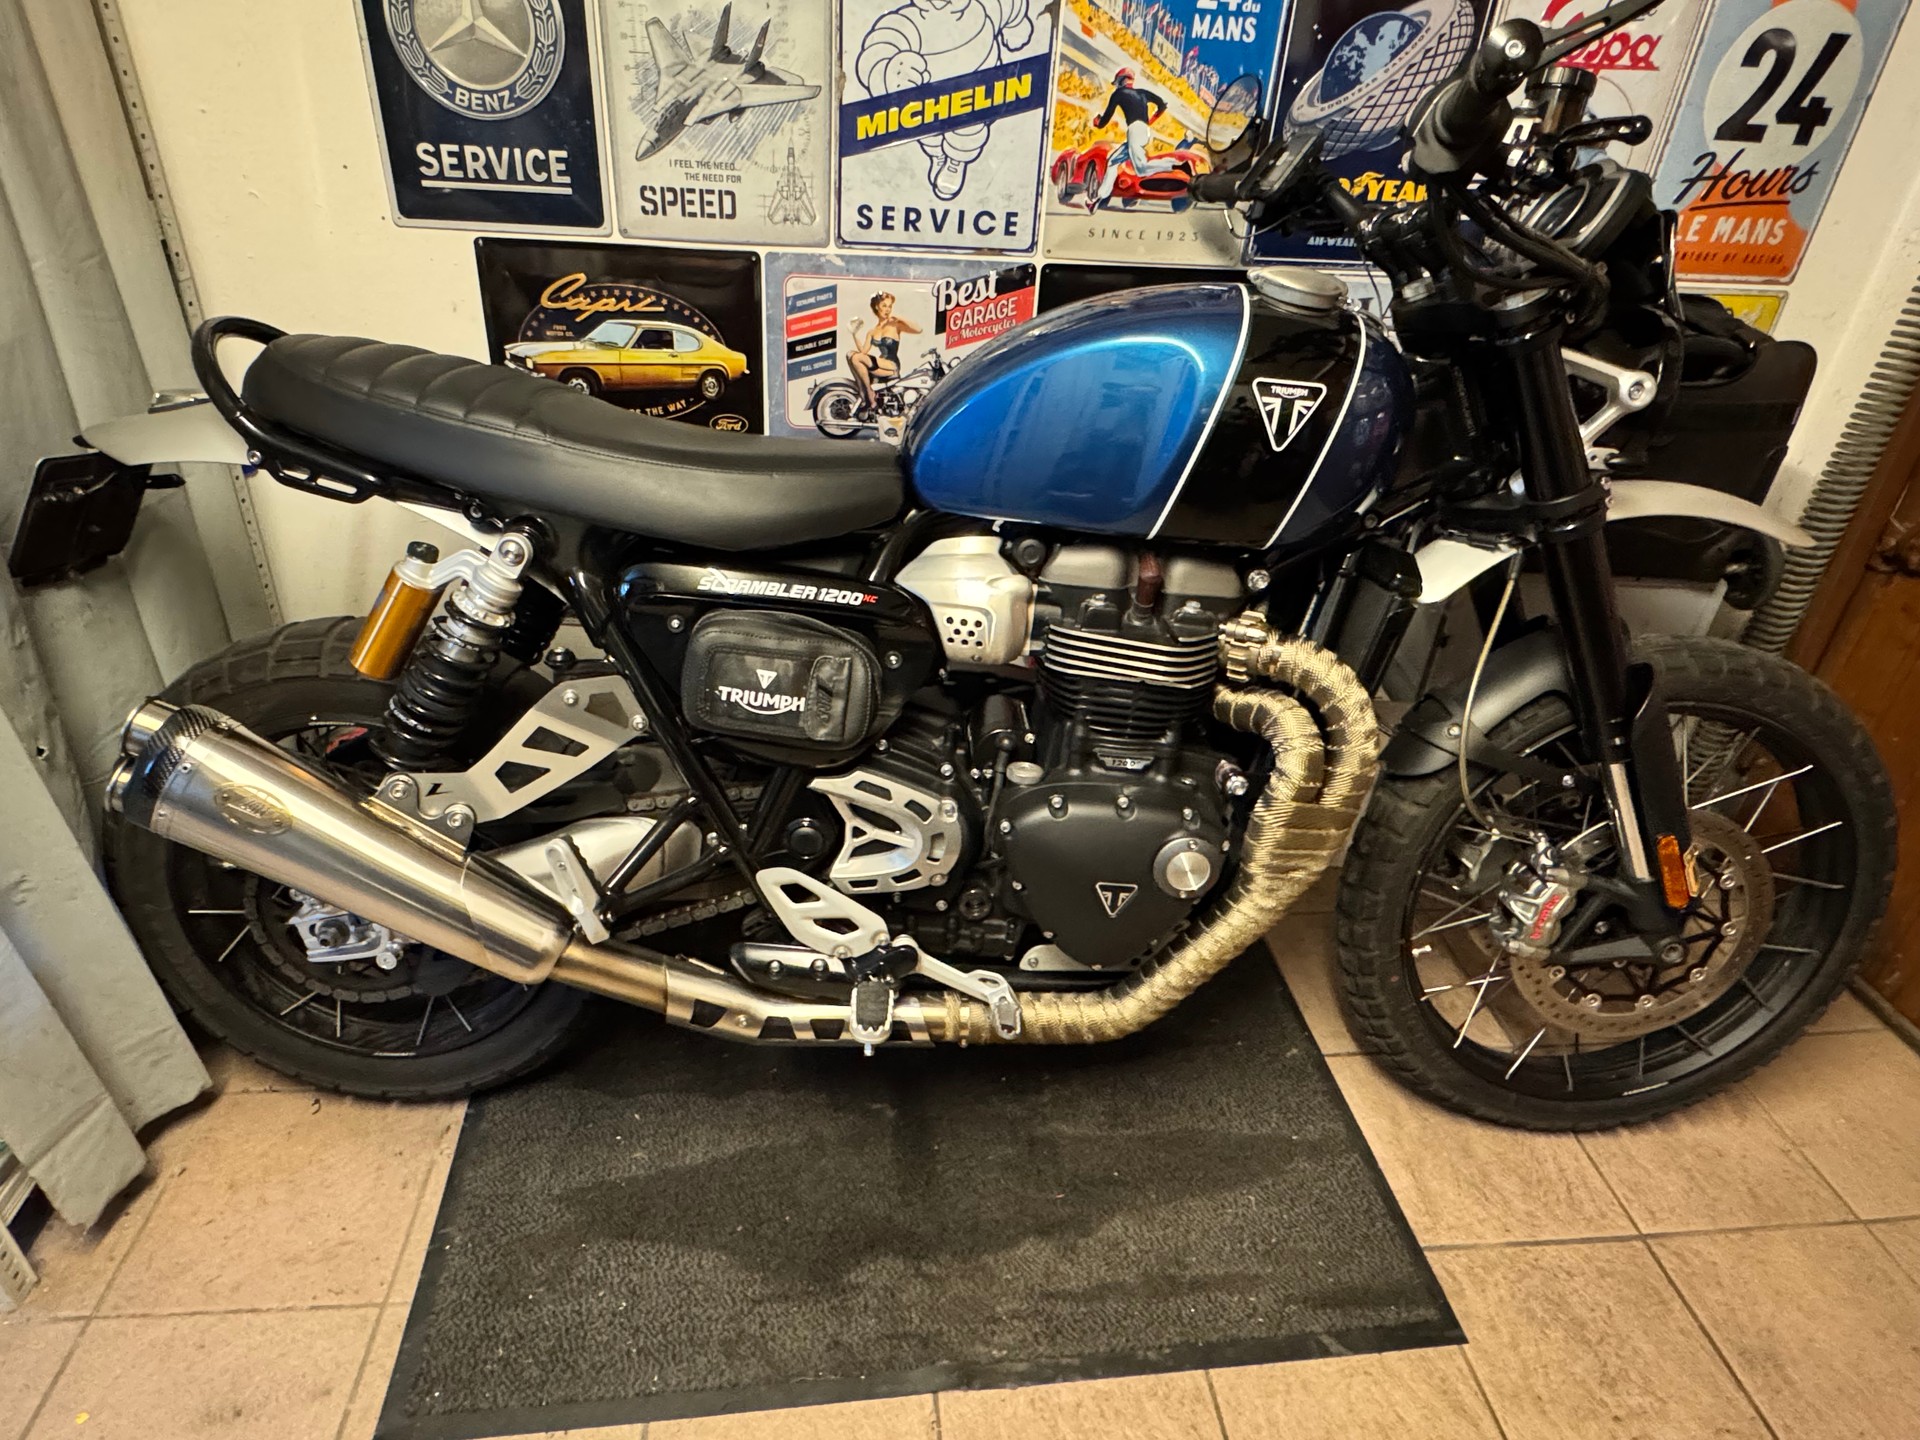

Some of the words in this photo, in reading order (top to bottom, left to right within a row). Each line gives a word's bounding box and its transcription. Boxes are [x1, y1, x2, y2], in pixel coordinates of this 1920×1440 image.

[1191, 13, 1257, 43] MANS
[455, 87, 516, 112] BENZ
[1714, 28, 1851, 147] 24
[856, 73, 1032, 141] MICHELIN
[415, 142, 571, 184] SERVICE
[674, 159, 694, 169] FEEL
[696, 160, 712, 170] THE
[1672, 148, 1820, 204] Hours
[684, 172, 701, 182] THE
[702, 173, 724, 183] NEED
[726, 174, 742, 184] FOR
[639, 185, 737, 220] SPEED
[856, 203, 1019, 237] SERVICE
[1088, 227, 1146, 241] SINCE
[1710, 216, 1788, 245] MANS
[540, 272, 665, 322] Capri
[932, 269, 999, 313] Best
[949, 296, 1018, 331] GARAGE
[960, 318, 1016, 339] Motorcycles
[1270, 385, 1309, 397] TRIUMPH
[645, 406, 664, 417] THE
[667, 400, 687, 412] WAY
[715, 419, 742, 431] Ford
[697, 576, 818, 601] SCRAMBLER
[716, 685, 806, 713] TRIUMPH
